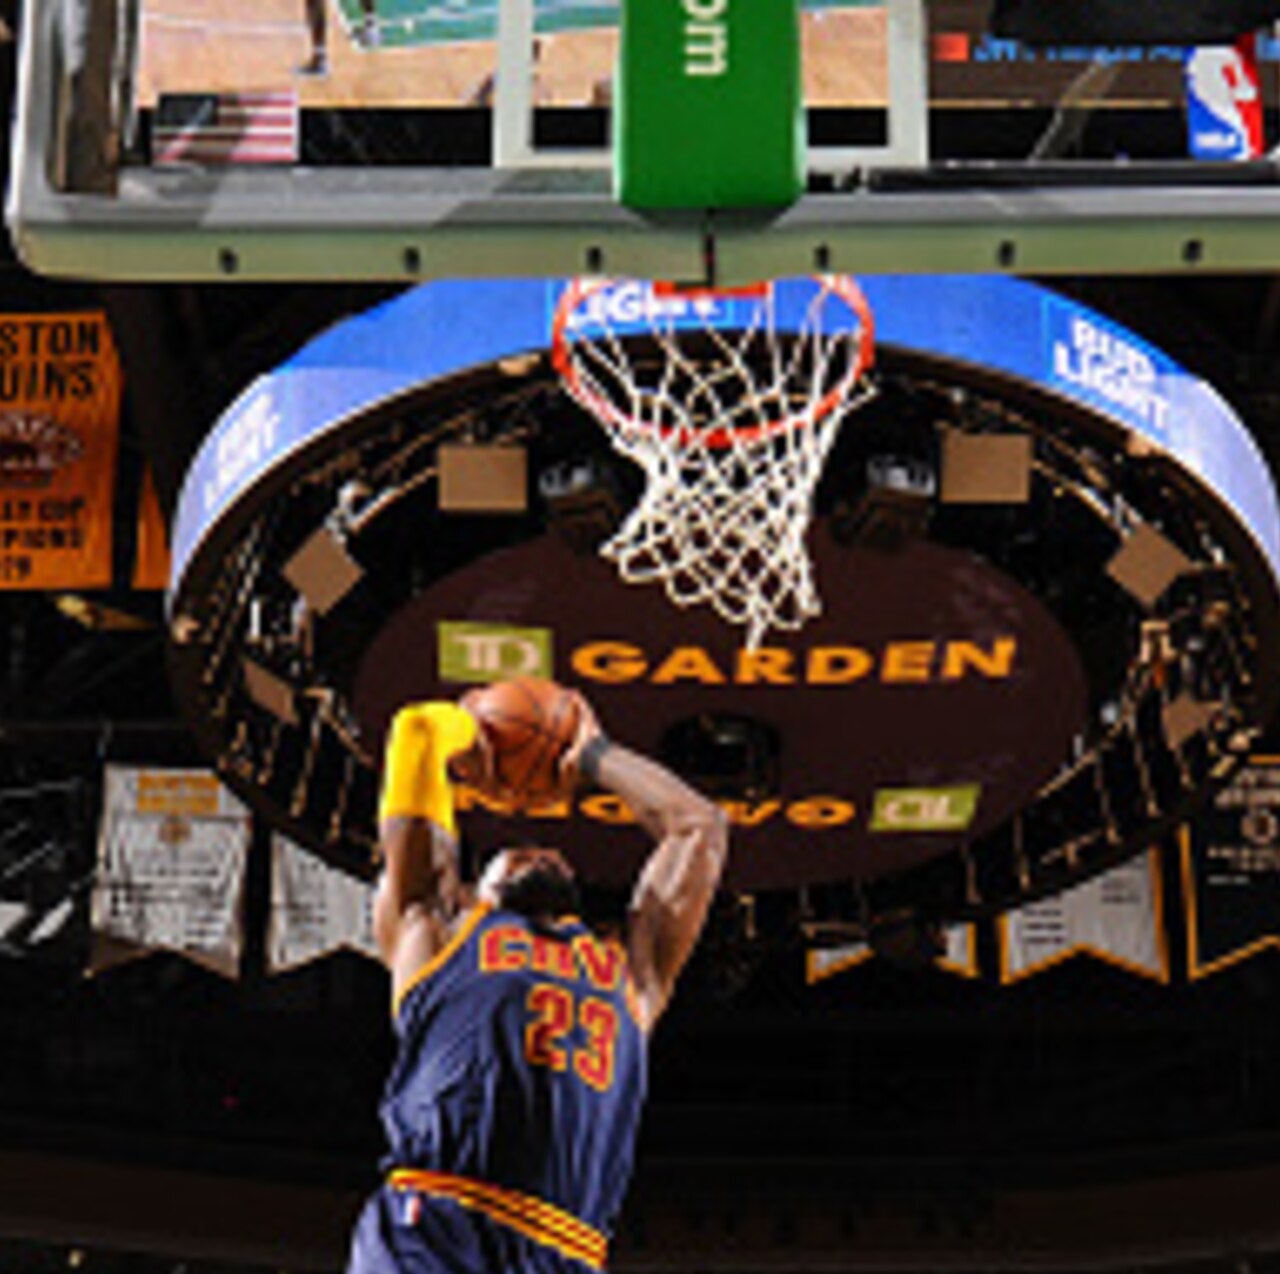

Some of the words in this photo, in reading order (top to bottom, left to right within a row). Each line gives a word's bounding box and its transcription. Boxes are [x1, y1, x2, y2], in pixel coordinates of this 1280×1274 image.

[1053, 341, 1171, 430] LIGHT
[1072, 318, 1158, 385] BUD
[451, 633, 542, 677] TD
[571, 636, 1016, 685] GARDEN
[525, 982, 619, 1092] 23
